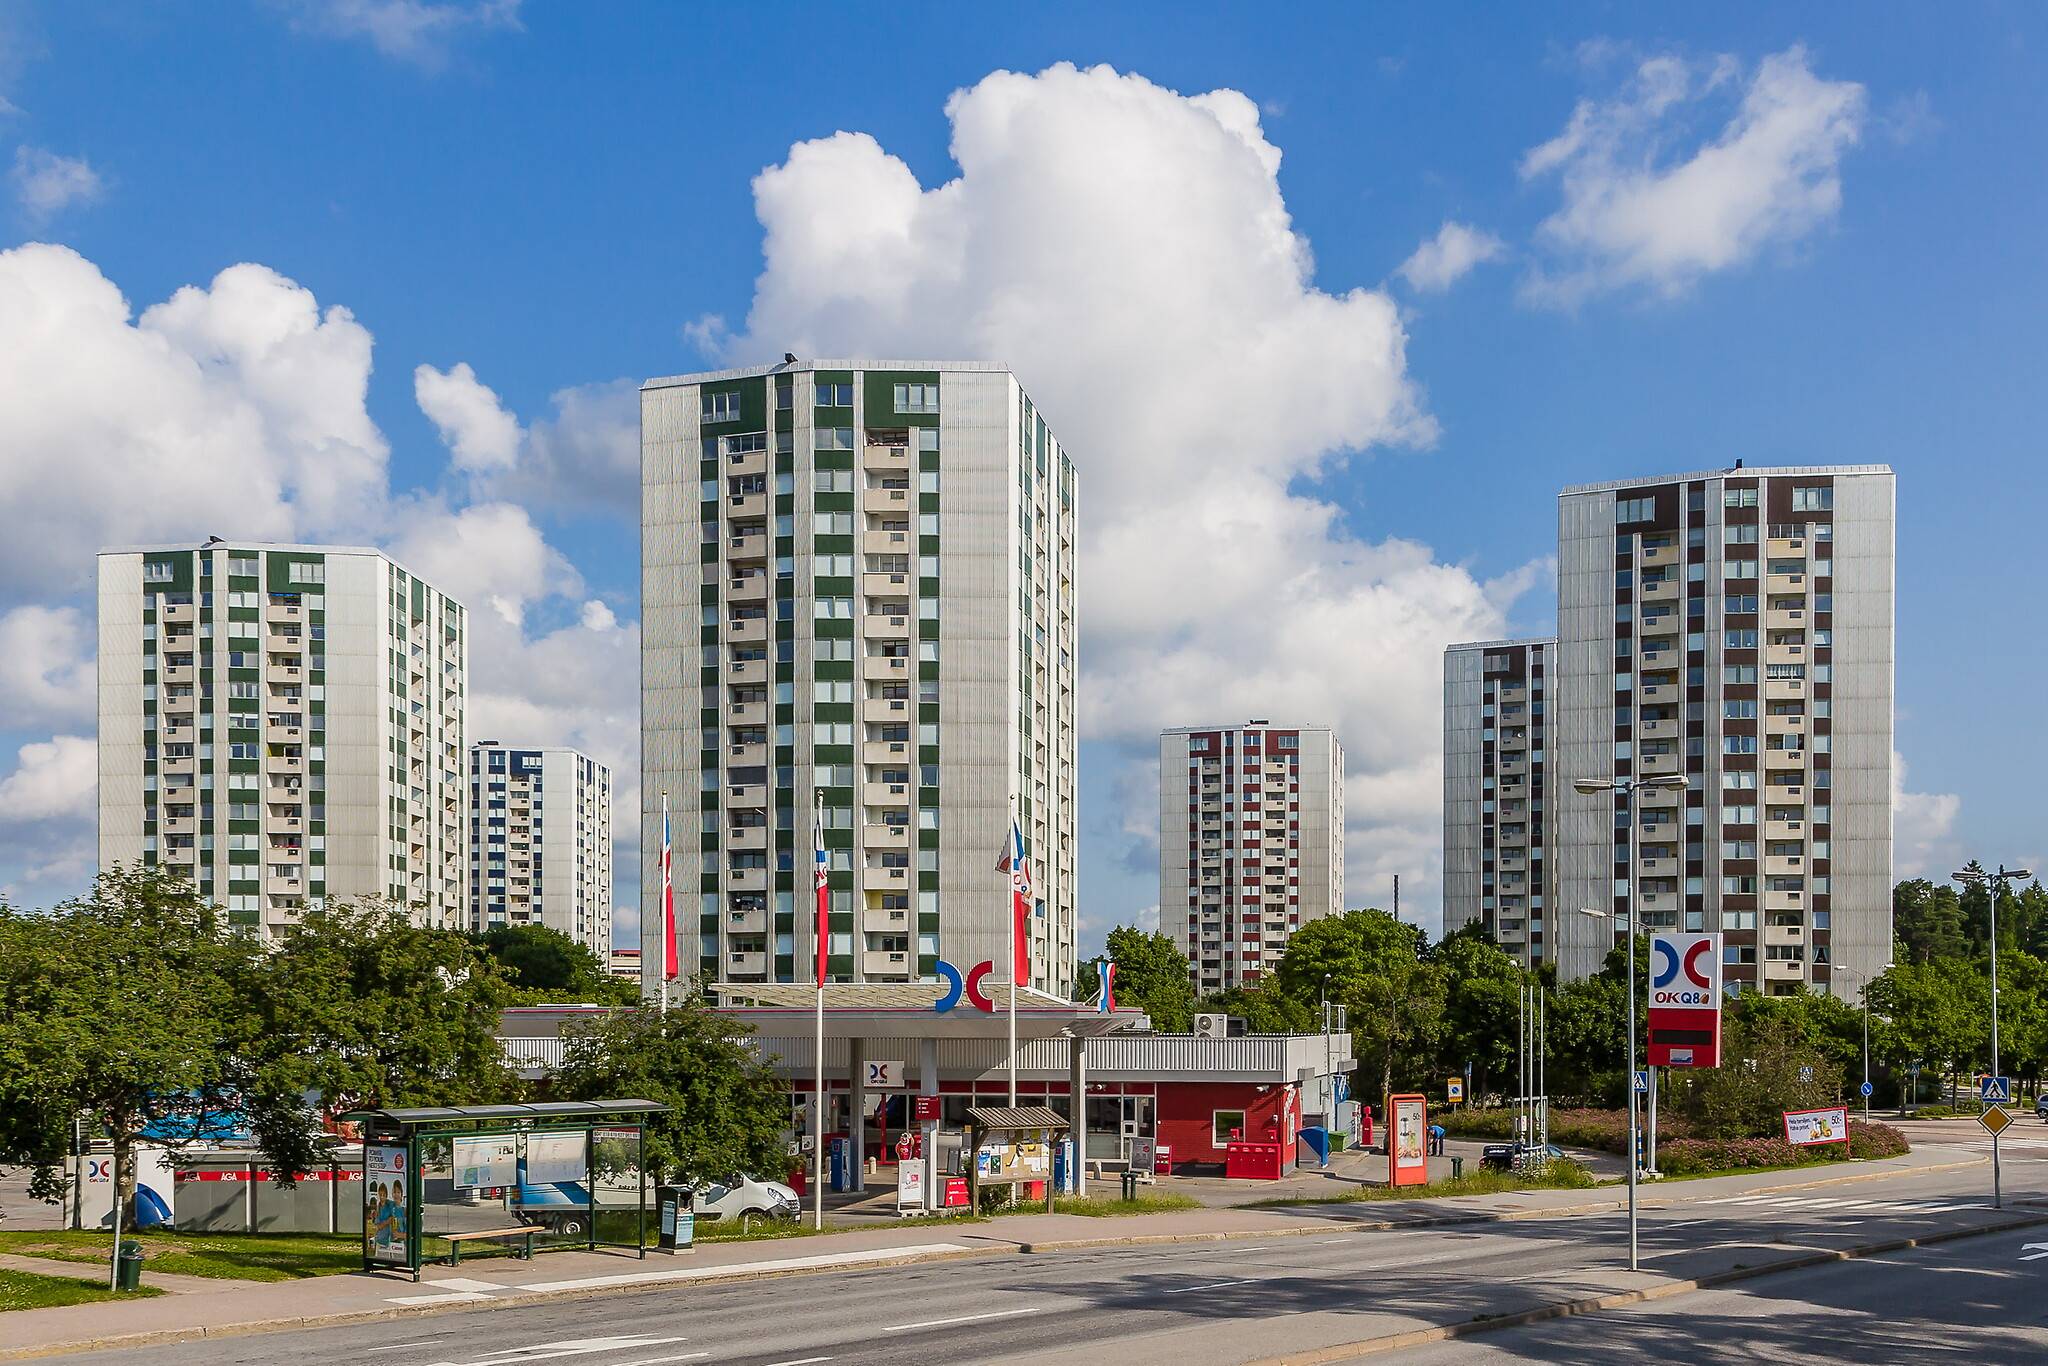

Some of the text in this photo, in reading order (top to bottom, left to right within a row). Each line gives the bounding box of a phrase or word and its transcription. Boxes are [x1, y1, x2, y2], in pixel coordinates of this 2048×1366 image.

[1654, 991, 1700, 1004] OKQ8
[221, 1173, 237, 1181] AGA
[348, 1172, 364, 1180] AGA
